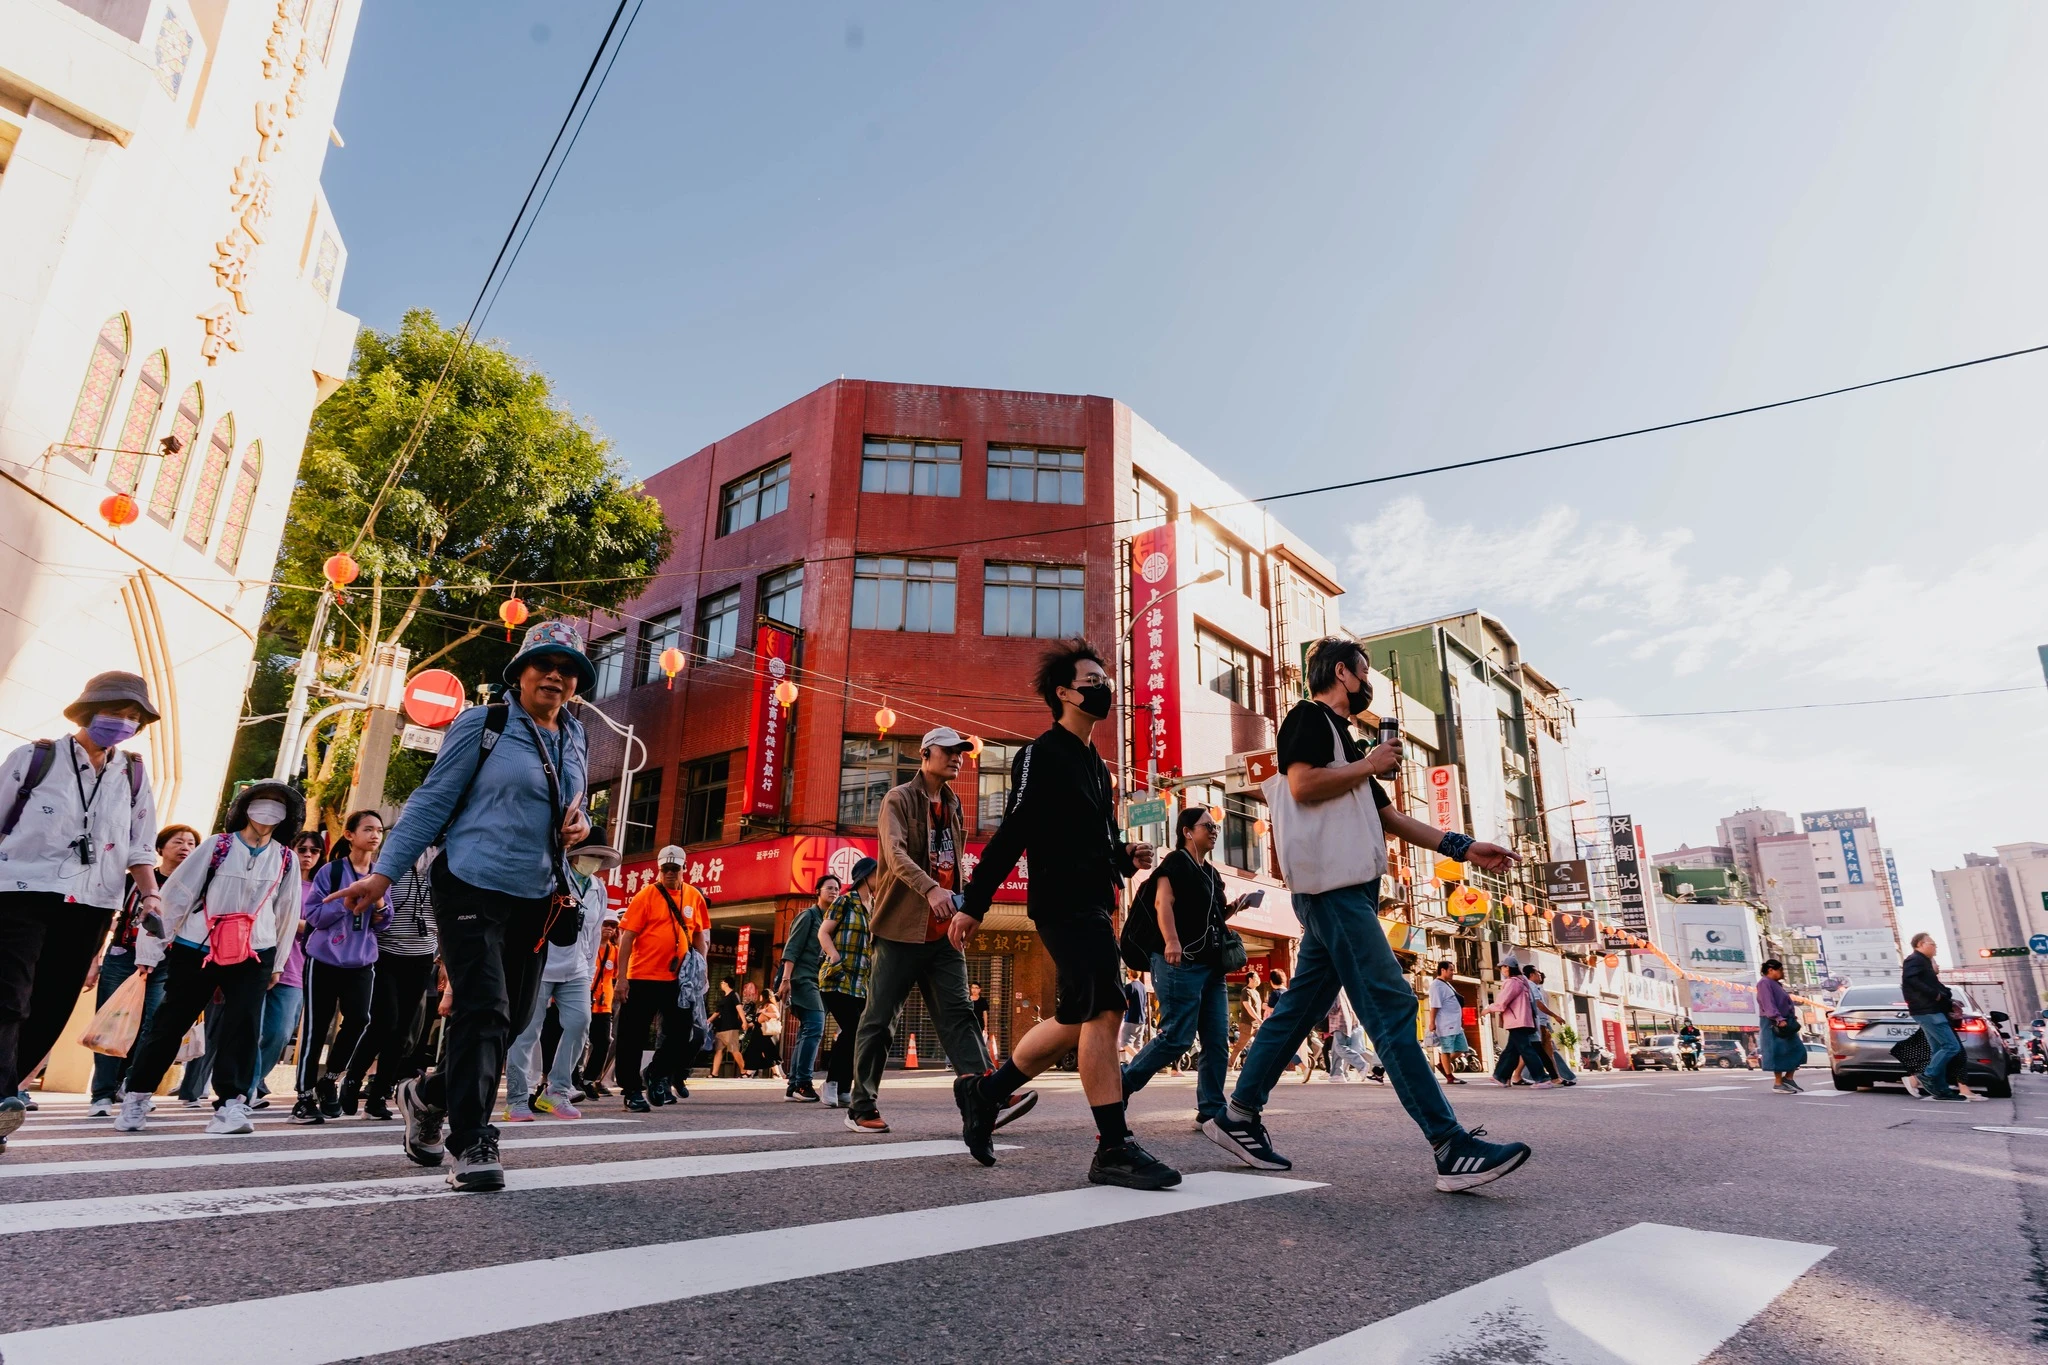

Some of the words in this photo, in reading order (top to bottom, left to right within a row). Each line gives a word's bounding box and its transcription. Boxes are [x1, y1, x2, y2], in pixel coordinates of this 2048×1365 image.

[407, 732, 438, 746] 禁止進入
[1611, 817, 1640, 890] 保衛站
[1006, 881, 1028, 890] SAVI
